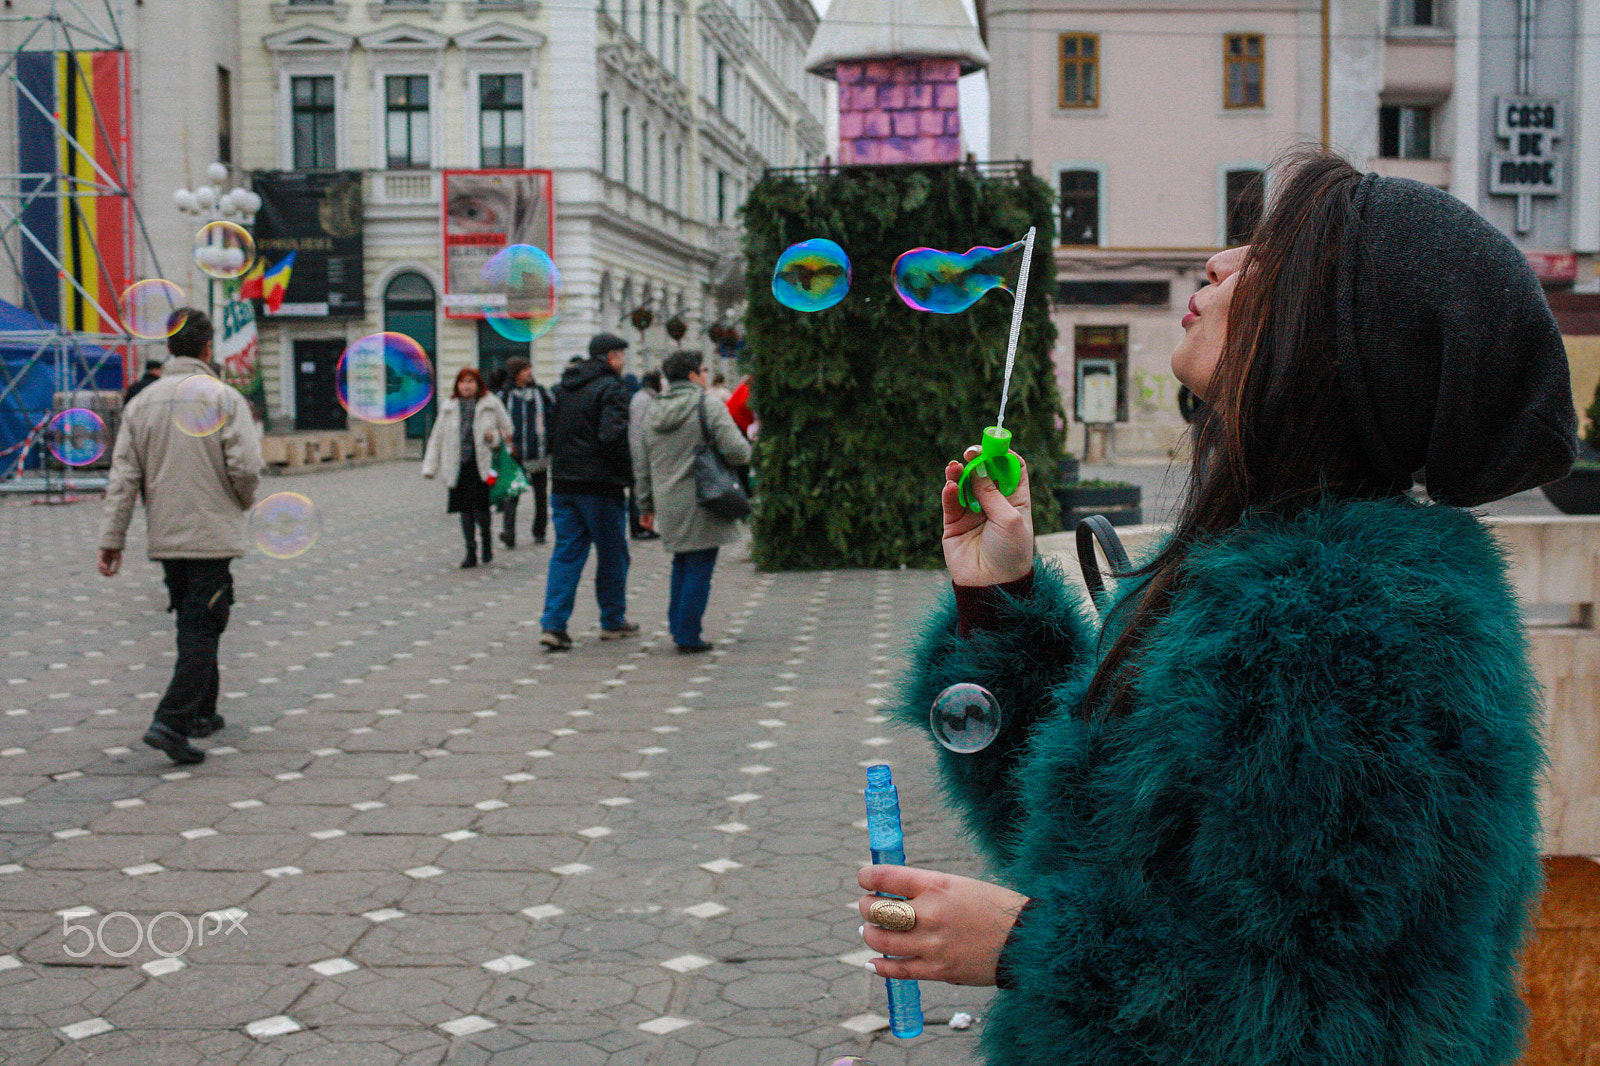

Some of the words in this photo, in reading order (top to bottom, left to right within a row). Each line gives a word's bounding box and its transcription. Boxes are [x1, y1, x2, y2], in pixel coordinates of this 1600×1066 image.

[1507, 105, 1555, 128] CASA
[1518, 133, 1543, 156] DE
[1500, 162, 1554, 185] MODE
